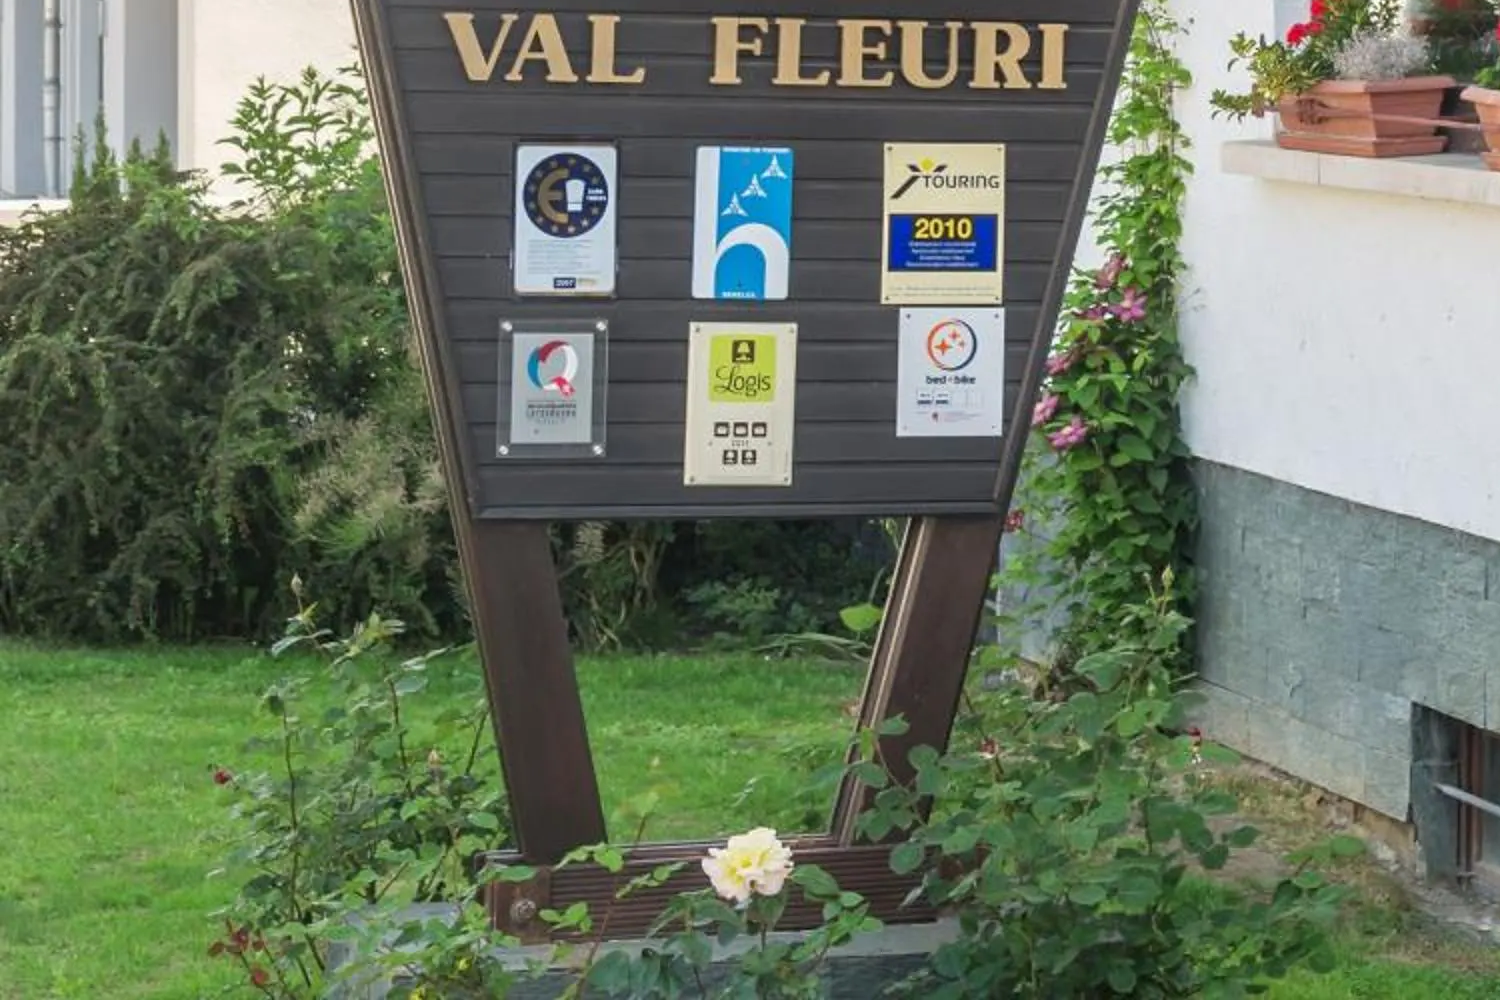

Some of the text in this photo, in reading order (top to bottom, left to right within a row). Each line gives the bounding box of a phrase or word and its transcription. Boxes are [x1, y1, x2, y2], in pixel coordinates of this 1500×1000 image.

[443, 13, 1069, 89] VAL FLEURI
[922, 175, 1000, 188] TOURING
[914, 217, 973, 239] 2010
[714, 365, 772, 397] Logis
